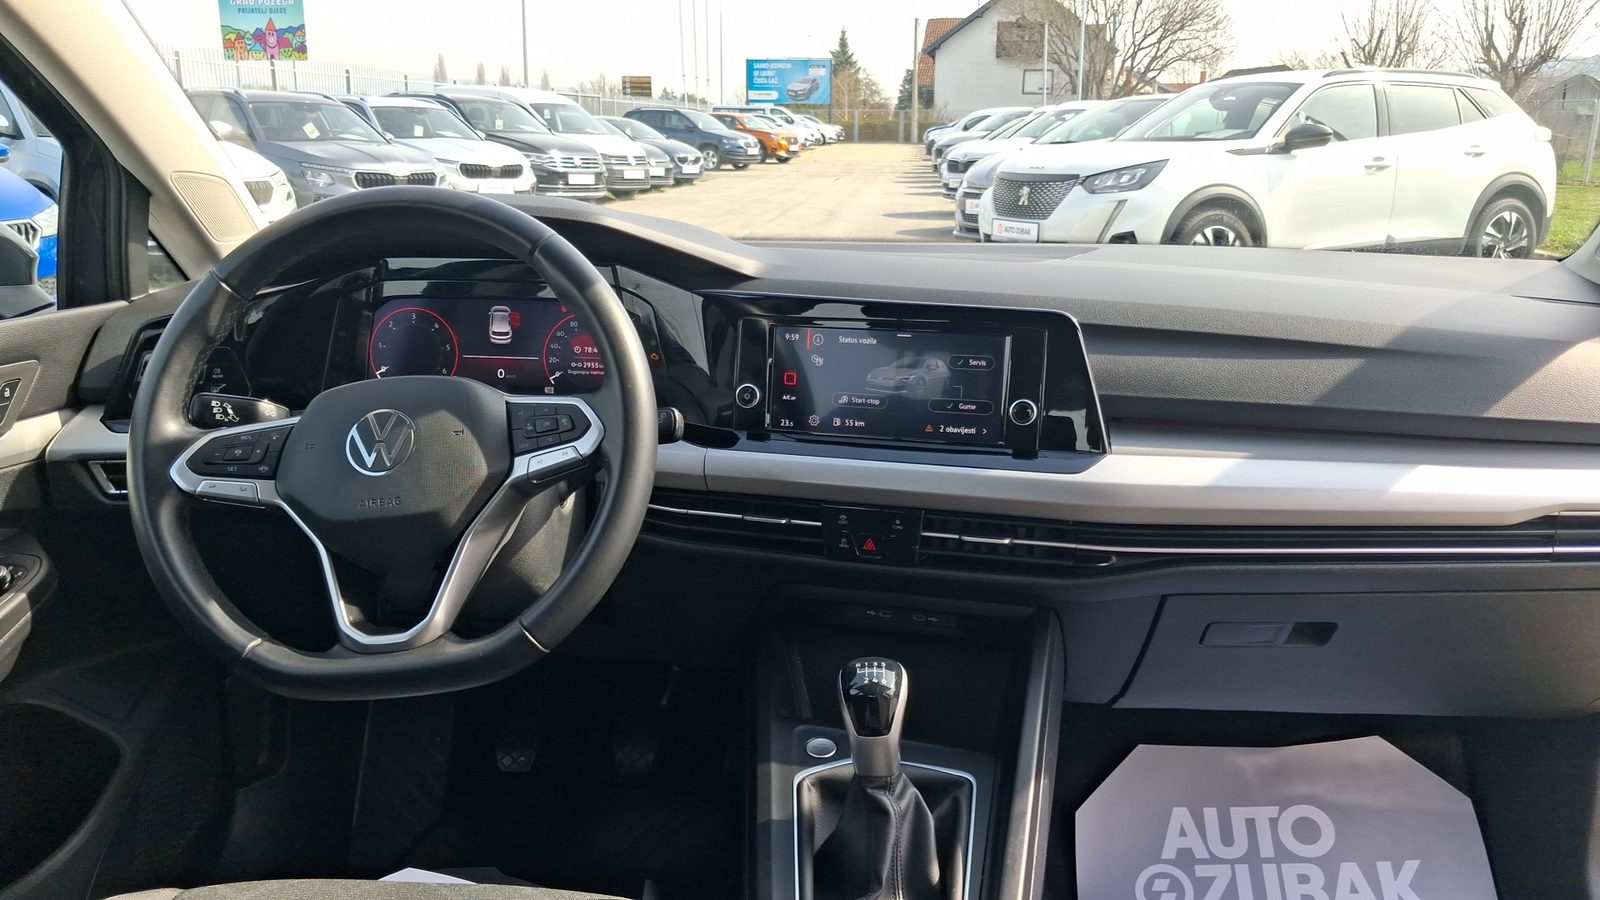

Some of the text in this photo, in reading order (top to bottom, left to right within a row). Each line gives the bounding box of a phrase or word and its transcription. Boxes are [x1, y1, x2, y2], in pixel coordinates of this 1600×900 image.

[1016, 227, 1031, 235] ZUBAK
[785, 333, 800, 341] 9:59
[838, 336, 877, 345] Status vozila
[583, 361, 599, 369] 2955
[497, 368, 505, 379] 0
[852, 397, 880, 406] Start-stop
[780, 419, 794, 427] 23.5
[845, 419, 854, 427] 55
[945, 426, 976, 435] obavijesti
[359, 497, 402, 509] AIRBAG
[1161, 804, 1336, 859] AUTO
[1193, 859, 1422, 900] ZUBAK
